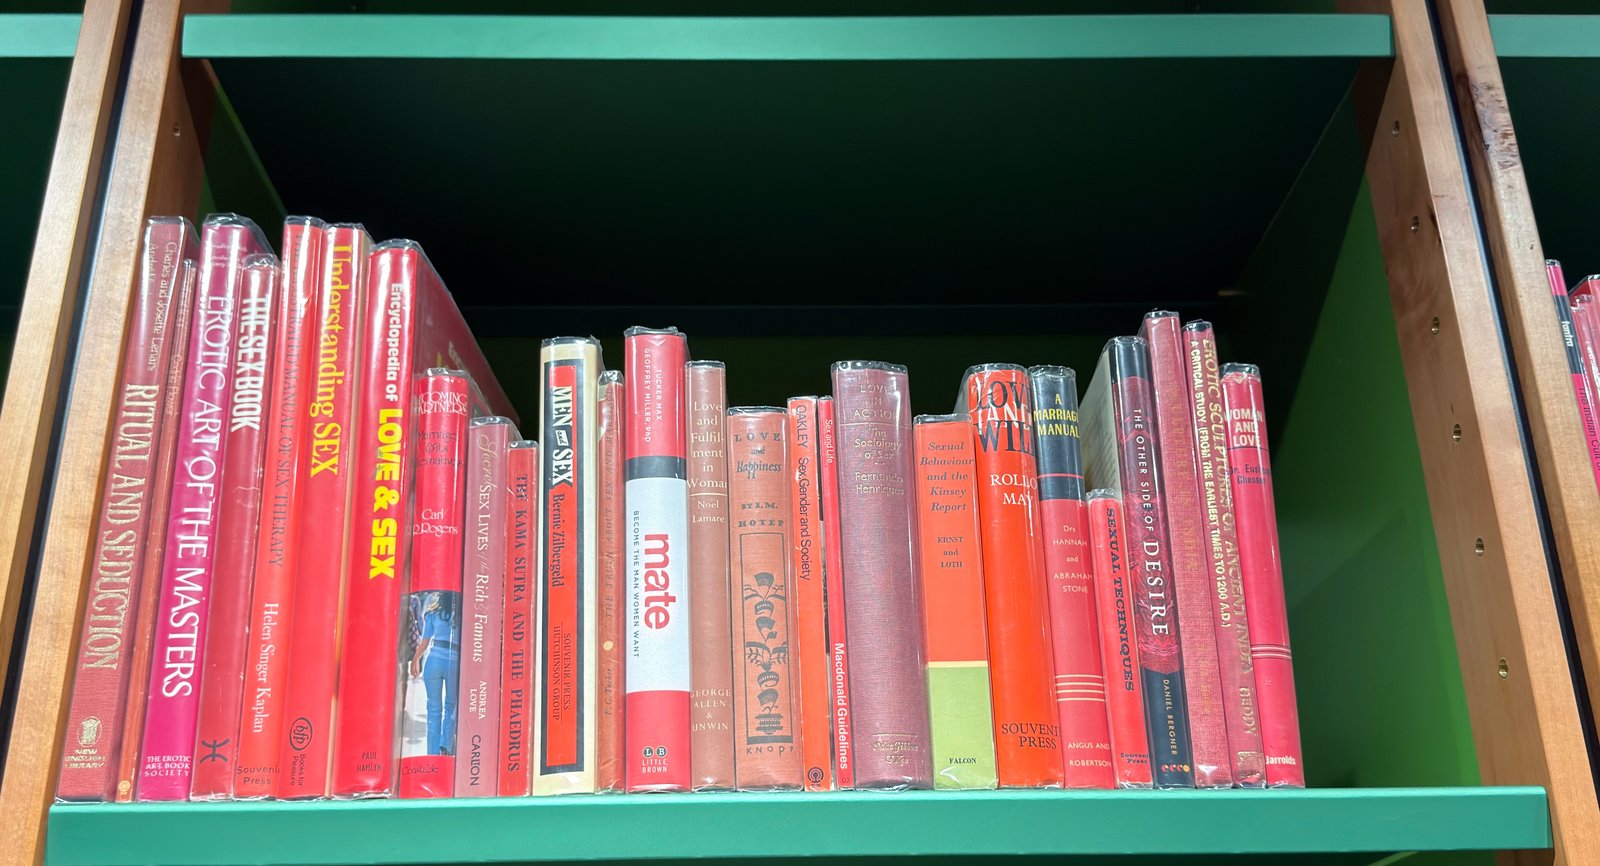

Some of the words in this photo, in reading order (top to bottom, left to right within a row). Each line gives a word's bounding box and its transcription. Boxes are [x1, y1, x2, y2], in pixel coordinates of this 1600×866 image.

[158, 279, 169, 297] and
[199, 296, 234, 390] EROTIC
[310, 244, 352, 418] Understanding
[386, 283, 404, 381] Encyclopedia
[236, 335, 267, 374] SEX
[644, 348, 652, 390] GEOFFREY
[1190, 348, 1203, 390] CRITICAL
[231, 374, 264, 432] BOOK
[278, 367, 298, 432] MANUAL
[552, 386, 573, 427] MEN
[644, 392, 652, 426] MILLER,
[694, 401, 722, 412] Love
[1054, 393, 1062, 406] A
[1194, 392, 1207, 424] STUDY
[115, 384, 159, 469] RITUAL
[192, 398, 223, 451] ART
[696, 416, 718, 426] and
[796, 404, 808, 449] OAKLEY
[824, 420, 833, 432] Sex
[984, 402, 1032, 431] AND
[1133, 408, 1144, 430] THE
[1224, 408, 1263, 422] WOMAN
[1234, 421, 1258, 433] AND
[1584, 407, 1596, 437] Indian
[375, 408, 403, 481] LOVE
[690, 432, 724, 443] Fulfil-
[734, 432, 781, 442] LOVE
[825, 433, 833, 448] and
[854, 438, 902, 452] Sociology
[1038, 423, 1080, 439] MANUAL
[1198, 426, 1212, 458] (FROM
[1232, 435, 1262, 448] LOVE
[278, 435, 292, 456] OF
[310, 422, 342, 478] SEX
[692, 448, 723, 458] ment
[826, 450, 834, 464] Life
[928, 441, 965, 452] Sexual
[1135, 435, 1148, 475] OTHER
[276, 460, 290, 488] SEX
[552, 448, 574, 488] SEX
[606, 450, 615, 474] AND
[702, 462, 714, 472] in
[736, 460, 782, 480] Happiness
[920, 456, 974, 466] Behaviour
[1202, 459, 1214, 480] THE
[186, 455, 217, 499] OF
[516, 474, 528, 502] THE
[605, 480, 614, 501] SEX
[926, 472, 948, 481] and
[949, 472, 968, 481] the
[990, 473, 1038, 490] ROLLO
[106, 473, 146, 525] AND
[374, 486, 400, 512] &
[479, 484, 492, 510] SEX
[697, 500, 720, 509] Noel
[798, 478, 810, 517] Gender
[930, 486, 967, 499] Kinsey
[1002, 492, 1034, 506] MAY
[1140, 482, 1152, 509] SIDE
[1202, 338, 1220, 398] EROTIC
[1224, 538, 1246, 616] ANCIENT
[1236, 623, 1254, 674] INDIA
[1205, 481, 1220, 526] EARLIEST
[421, 508, 444, 520] Carl
[552, 494, 565, 530] Bernie
[692, 514, 725, 524] Lamare
[931, 502, 967, 514] Report
[178, 501, 213, 558] THE
[270, 492, 288, 567] THERAPY
[478, 514, 490, 551] LIVES
[514, 510, 528, 550] KAMA
[605, 508, 614, 544] ABOUT
[738, 519, 784, 528] HOTEP
[800, 518, 810, 537] and
[1063, 524, 1076, 533] Drs
[1144, 515, 1154, 532] OF
[369, 518, 398, 580] SEX
[937, 536, 964, 544] ERNST
[943, 548, 960, 556] and
[1052, 538, 1088, 547] HANNAH
[1106, 508, 1122, 574] SEXUAL
[1210, 528, 1224, 560] TIMES
[550, 530, 565, 588] Zilbergeld
[604, 552, 614, 590] TRUTH
[800, 540, 812, 581] Society
[940, 560, 963, 569] LOTH
[476, 574, 489, 602] Rich
[512, 557, 527, 603] SUTRA
[644, 534, 677, 630] mate
[1062, 585, 1088, 594] STONE
[1142, 540, 1169, 636] DESIRE
[1216, 576, 1228, 600] 1200
[82, 530, 137, 670] SEDUCTION
[604, 594, 614, 619] THE
[262, 603, 279, 640] Helen
[512, 612, 525, 642] AND
[1219, 602, 1231, 628] A.D.)
[162, 567, 206, 697] MASTERS
[473, 613, 488, 663] Famous
[1113, 576, 1135, 692] TECHNIQUES
[256, 644, 275, 683] Singer
[510, 650, 524, 681] THE
[552, 626, 562, 686] HUTCHINSON
[563, 633, 572, 679] SOUVENIR
[834, 643, 847, 706] Macdonald
[469, 688, 478, 714] LOVE
[478, 680, 488, 720] ANDREA
[552, 688, 561, 721] GROUP
[562, 682, 571, 711] PRESS
[694, 700, 726, 708] ALLEN
[1162, 679, 1172, 712] DANIEL
[252, 688, 271, 733] Kaplan
[508, 689, 524, 772] PHAEDRUS
[692, 722, 729, 732] UNWIN
[837, 707, 848, 770] Guidelines
[1166, 714, 1178, 756] BERGNER
[362, 752, 377, 760] PAUL
[1018, 736, 1057, 750] PRESS
[1068, 742, 1094, 750] ANGUS
[1095, 742, 1110, 750] AND
[146, 762, 162, 770] ART
[164, 762, 190, 770] BOOK
[162, 754, 192, 762] EROTIC
[356, 764, 382, 773] HAMLYN
[469, 734, 482, 786] CARLTON
[642, 766, 668, 774] BROWN
[1068, 759, 1112, 768] ROBERTSON
[1265, 754, 1297, 766] Jarrolds
